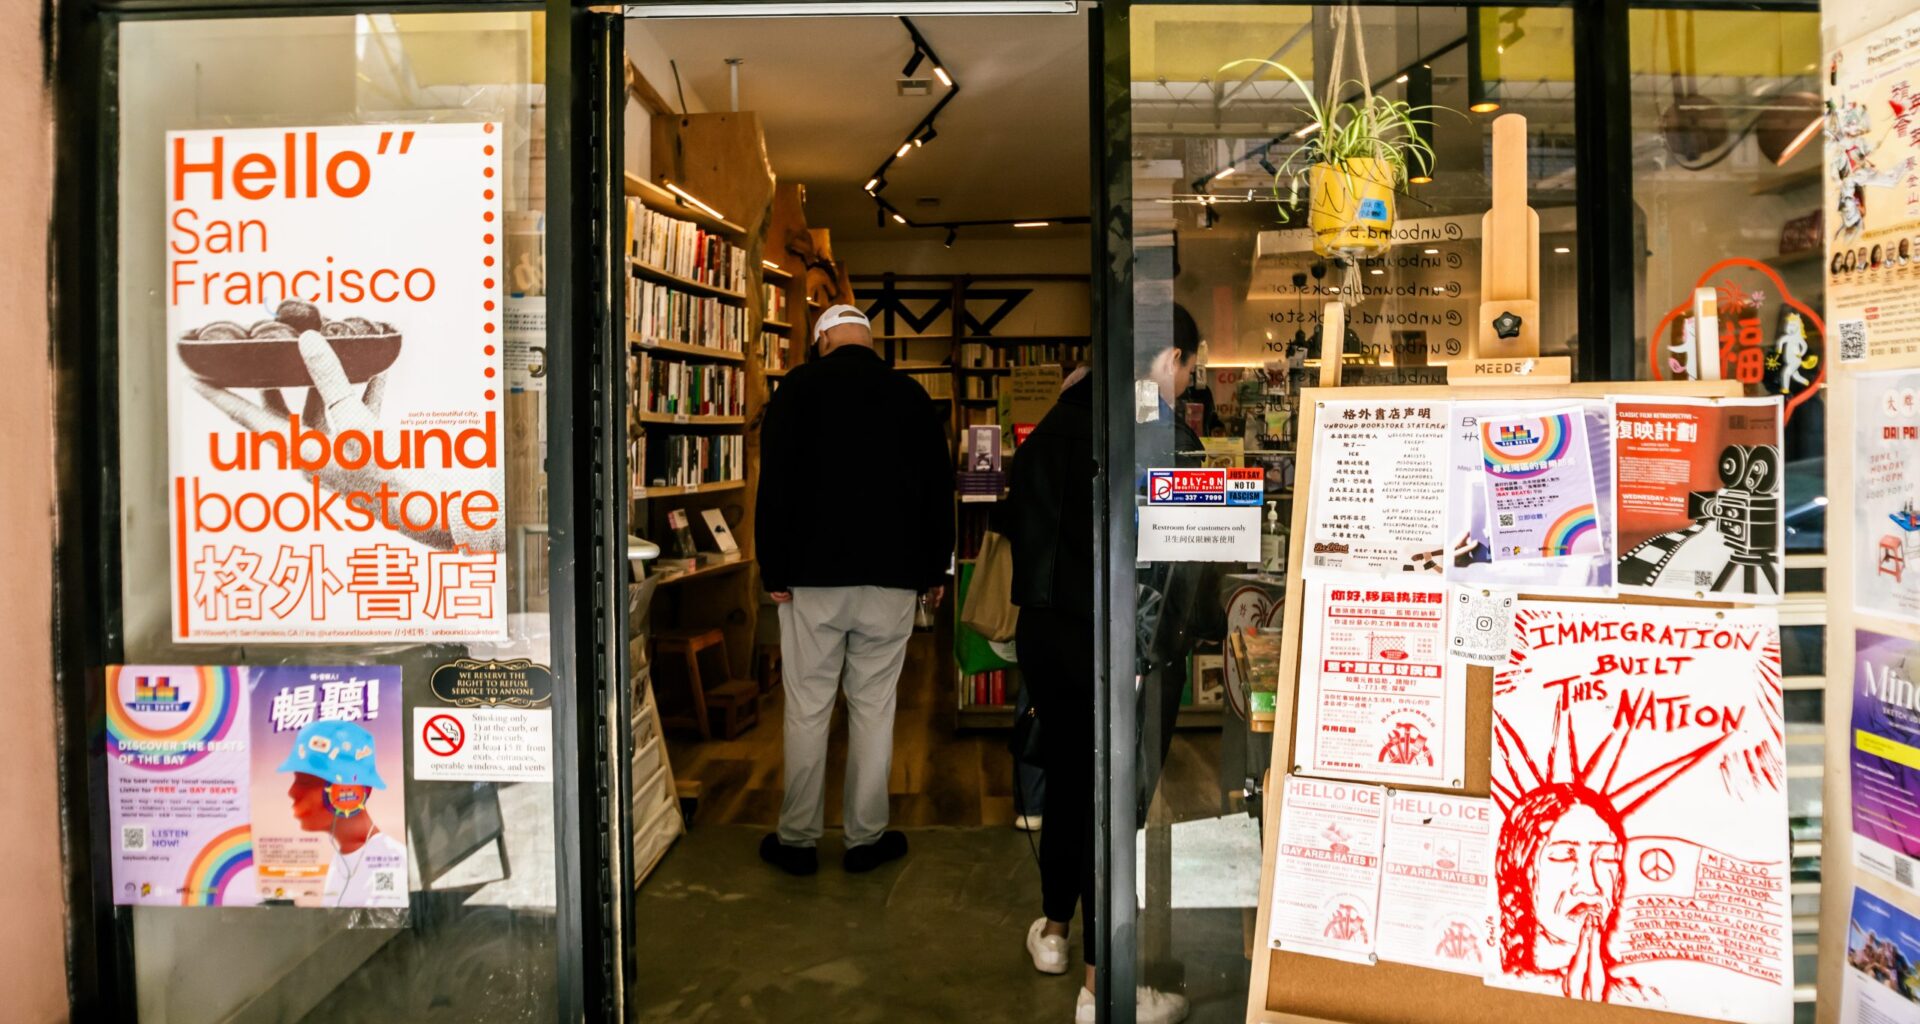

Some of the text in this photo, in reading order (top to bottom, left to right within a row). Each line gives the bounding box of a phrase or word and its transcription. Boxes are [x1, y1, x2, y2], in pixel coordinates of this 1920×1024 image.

[171, 208, 267, 254] San
[171, 256, 436, 305] Francisco
[1475, 363, 1526, 374] MEEDE
[432, 410, 463, 418] beautiful
[209, 411, 496, 471] unbound
[1883, 426, 1899, 440] DAI
[1174, 477, 1223, 485] POLY-ON
[193, 475, 499, 532] bookstore
[1152, 523, 1185, 531] Restroom
[1186, 523, 1196, 531] for
[1232, 524, 1246, 532] only
[193, 544, 497, 620] 格外書店
[1530, 620, 1760, 650] IMMIGRATION
[1450, 649, 1477, 660] UNBOUND
[1590, 654, 1695, 675] BUILT
[1543, 675, 1608, 711] THIS
[1613, 687, 1746, 732] NATION
[472, 714, 527, 724] Smoking only
[483, 733, 490, 741] if
[507, 724, 528, 733] curb,
[118, 741, 180, 751] DISCOVER
[182, 741, 205, 751] THE
[526, 744, 546, 752] from
[119, 755, 187, 765] OF THE BAY
[430, 761, 546, 771] operable windows, and vents
[1289, 781, 1381, 805] HELLO ICE
[1392, 798, 1452, 817] HELLO
[1458, 805, 1489, 821] ICE
[152, 830, 188, 838] LISTEN
[1282, 844, 1376, 867] BAY AREA HATES U
[1708, 853, 1769, 876] MEXICO
[1387, 863, 1408, 874] BAY
[1410, 866, 1438, 879] AREA
[1441, 871, 1476, 884] HATES
[1478, 875, 1487, 886] U
[1702, 867, 1782, 889] PHILIPPINES
[1716, 880, 1773, 901] SALVADOR
[1706, 902, 1765, 920] ETHIOPIA
[1633, 920, 1662, 930] SOUTH
[1735, 919, 1780, 936] CONGO
